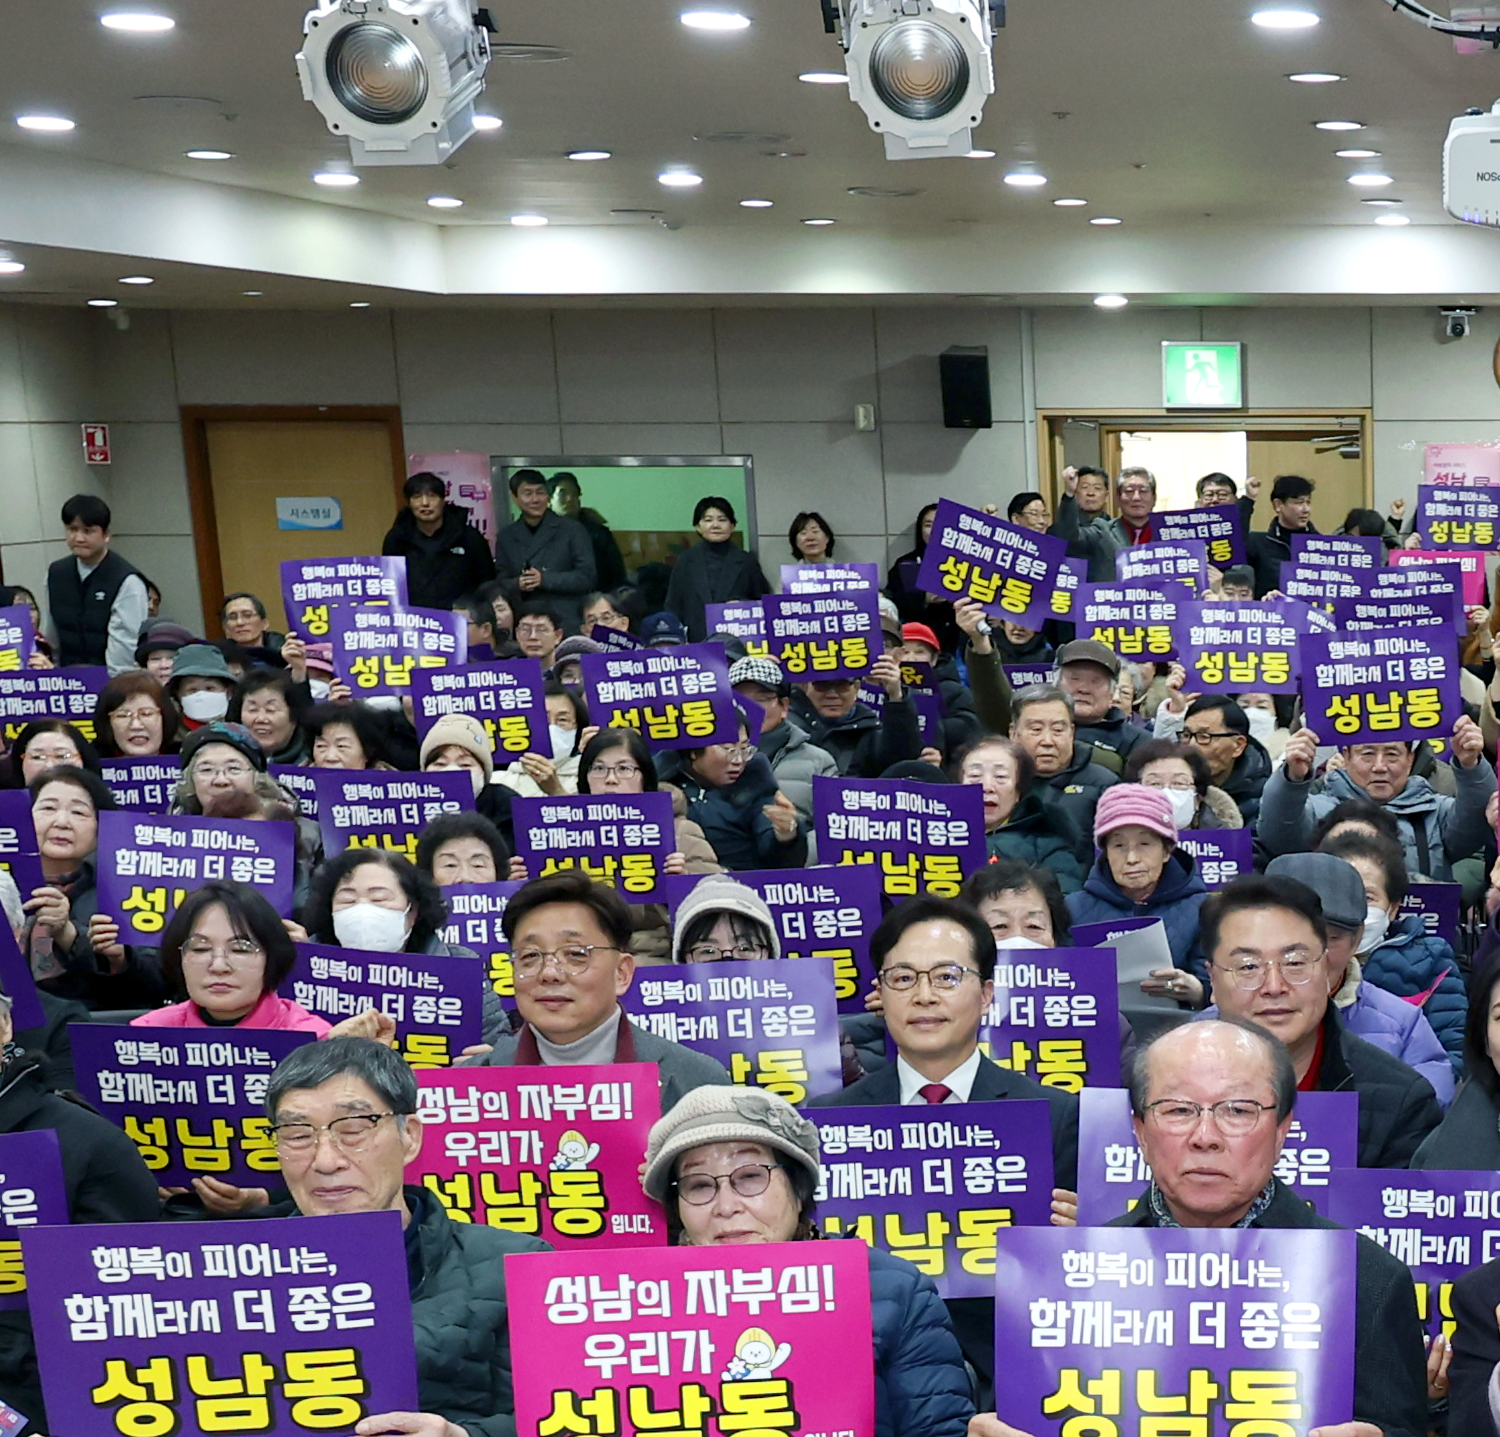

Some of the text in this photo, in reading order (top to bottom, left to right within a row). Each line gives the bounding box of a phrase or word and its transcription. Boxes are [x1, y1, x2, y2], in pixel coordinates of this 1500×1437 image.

[290, 509, 330, 518] 시스템실
[1465, 504, 1498, 517] 더 좋은
[941, 522, 1047, 580] 함께라서 좋은
[959, 514, 1039, 560] 행복이 피어나는,
[1428, 521, 1494, 545] 성남동
[937, 554, 1034, 615] 성남동
[1328, 638, 1430, 659] 행복이 피어나는,
[597, 672, 716, 703] 함께라서 좋은
[1316, 657, 1445, 687] 함께라서 좋은
[1326, 687, 1442, 734] 성남동
[411, 1083, 632, 1123] 성남의 자부심!
[445, 1131, 543, 1166] 우리가
[423, 1169, 653, 1237] 성남동 입니다.
[92, 1243, 337, 1282] 행복이 피어나는,
[1062, 1250, 1290, 1291] 행복이 피어나는,
[64, 1283, 375, 1341] 함께라서 더 좋은
[544, 1265, 835, 1324] 성남의 자부심!
[1029, 1298, 1322, 1350] 함께라서 더 좋은
[584, 1330, 715, 1379] 우리가
